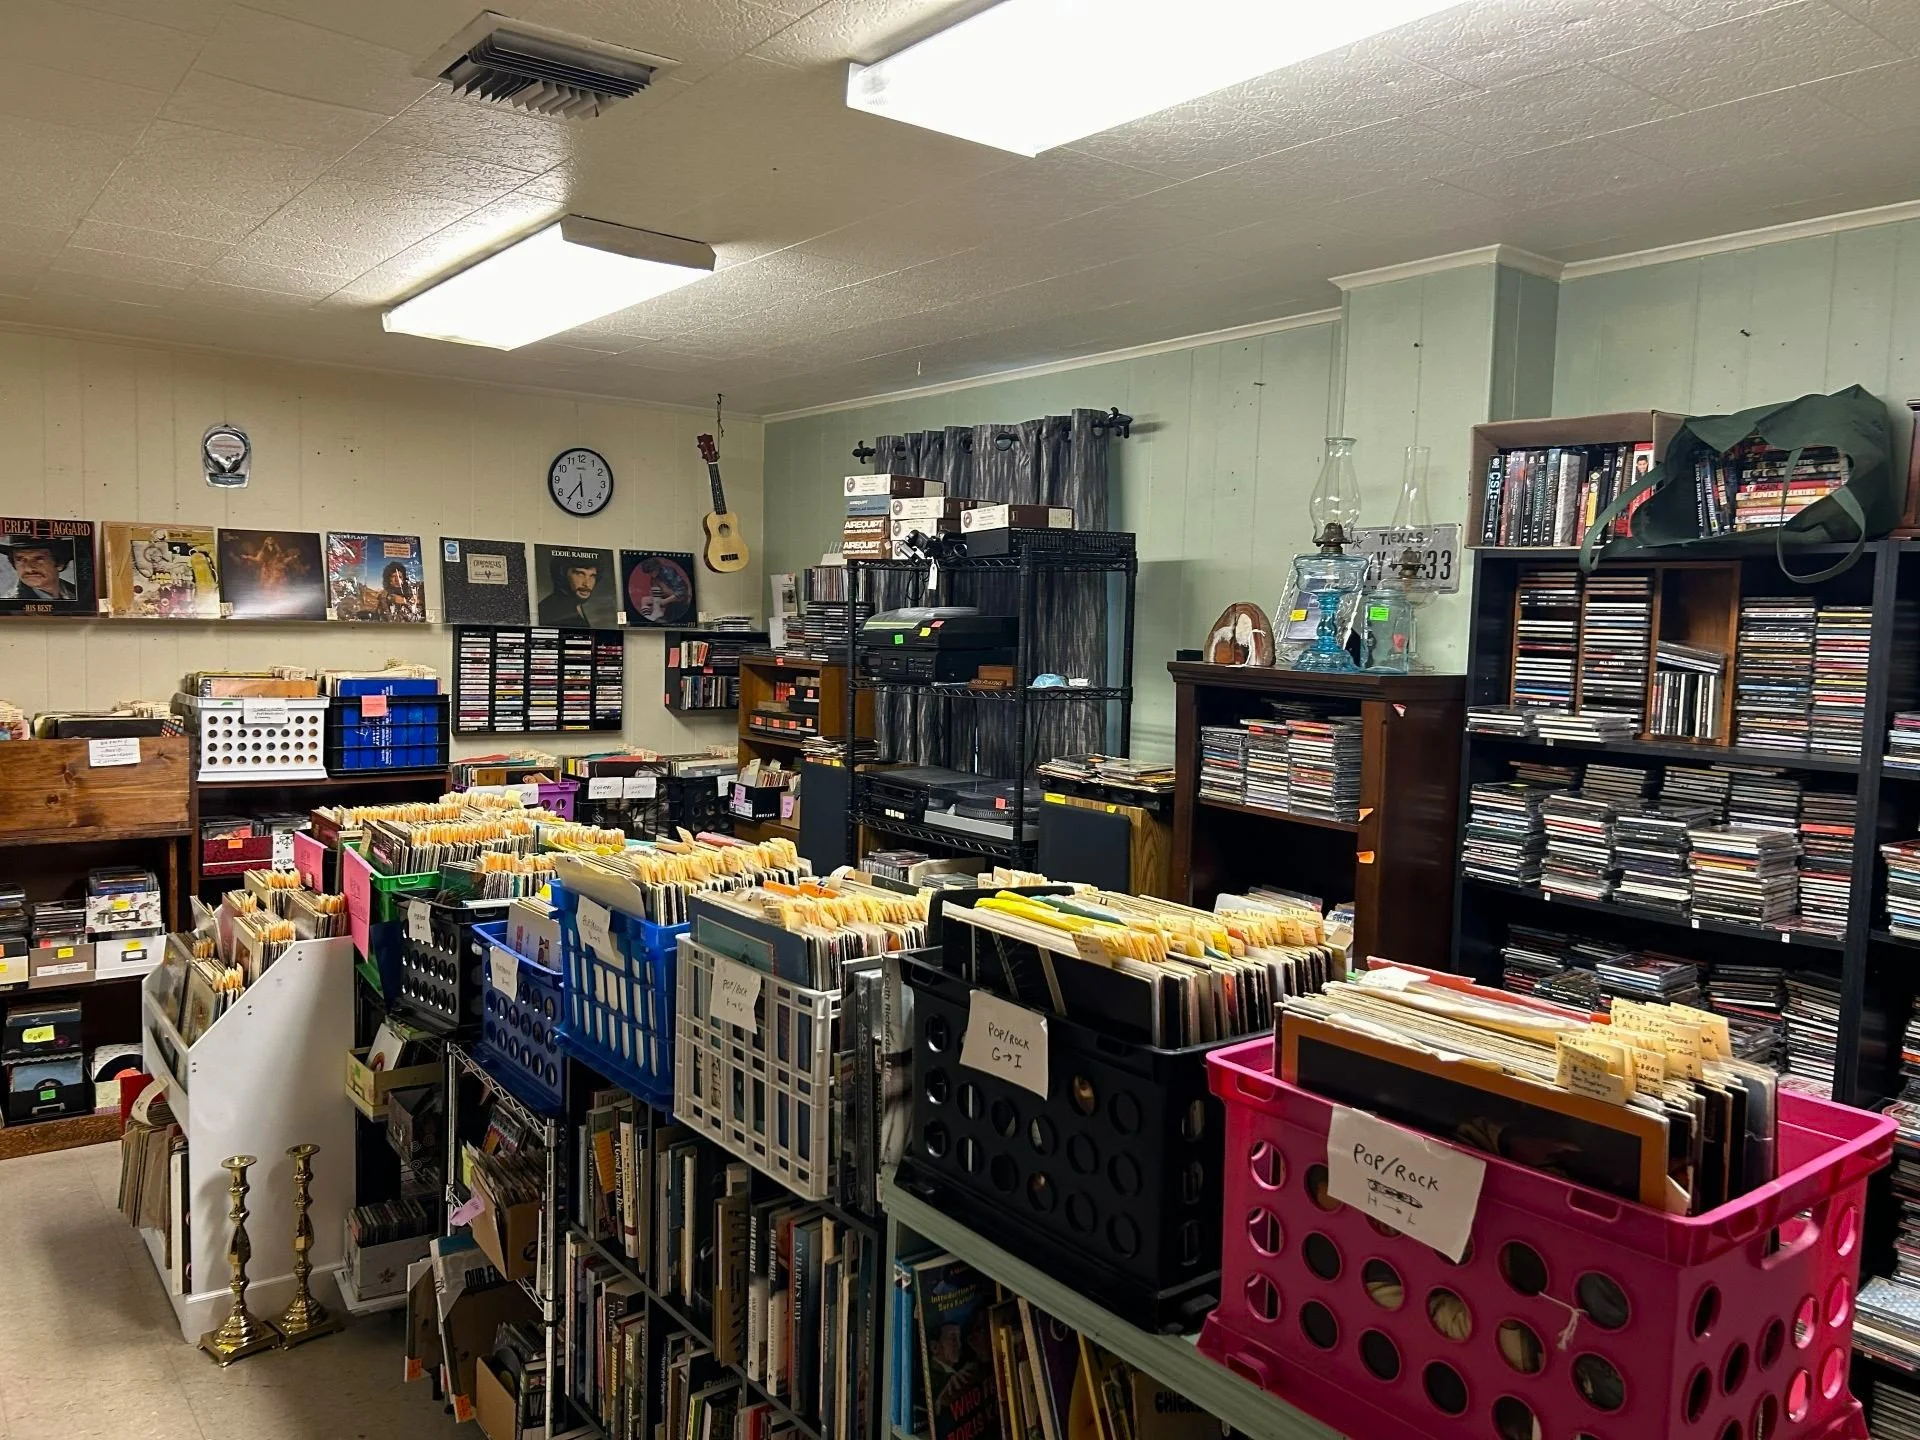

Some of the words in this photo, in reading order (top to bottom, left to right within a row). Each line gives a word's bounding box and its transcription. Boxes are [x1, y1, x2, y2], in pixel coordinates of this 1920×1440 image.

[578, 454, 586, 463] 12
[558, 465, 567, 473] 10
[597, 468, 603, 476] 2
[555, 476, 560, 484] 9
[1490, 472, 1500, 499] CSI:
[558, 488, 563, 496] 8
[576, 501, 582, 509] 6
[587, 499, 593, 507] 5
[0, 520, 31, 537] ERLE
[32, 520, 90, 539] HAGGARD
[844, 520, 884, 529] AIREQUIPT
[1379, 532, 1424, 545] TEXAS
[843, 542, 880, 550] AIREQUIPT
[988, 1022, 1029, 1050] POP/ROCK
[992, 1047, 1000, 1061] G
[1014, 1054, 1022, 1068] I
[614, 1149, 623, 1169] Good
[1354, 1143, 1439, 1191] POP/ROCK
[615, 1171, 623, 1188] Year
[1407, 1212, 1416, 1225] L
[794, 1256, 802, 1297] HARM'S
[951, 1388, 980, 1421] WHO
